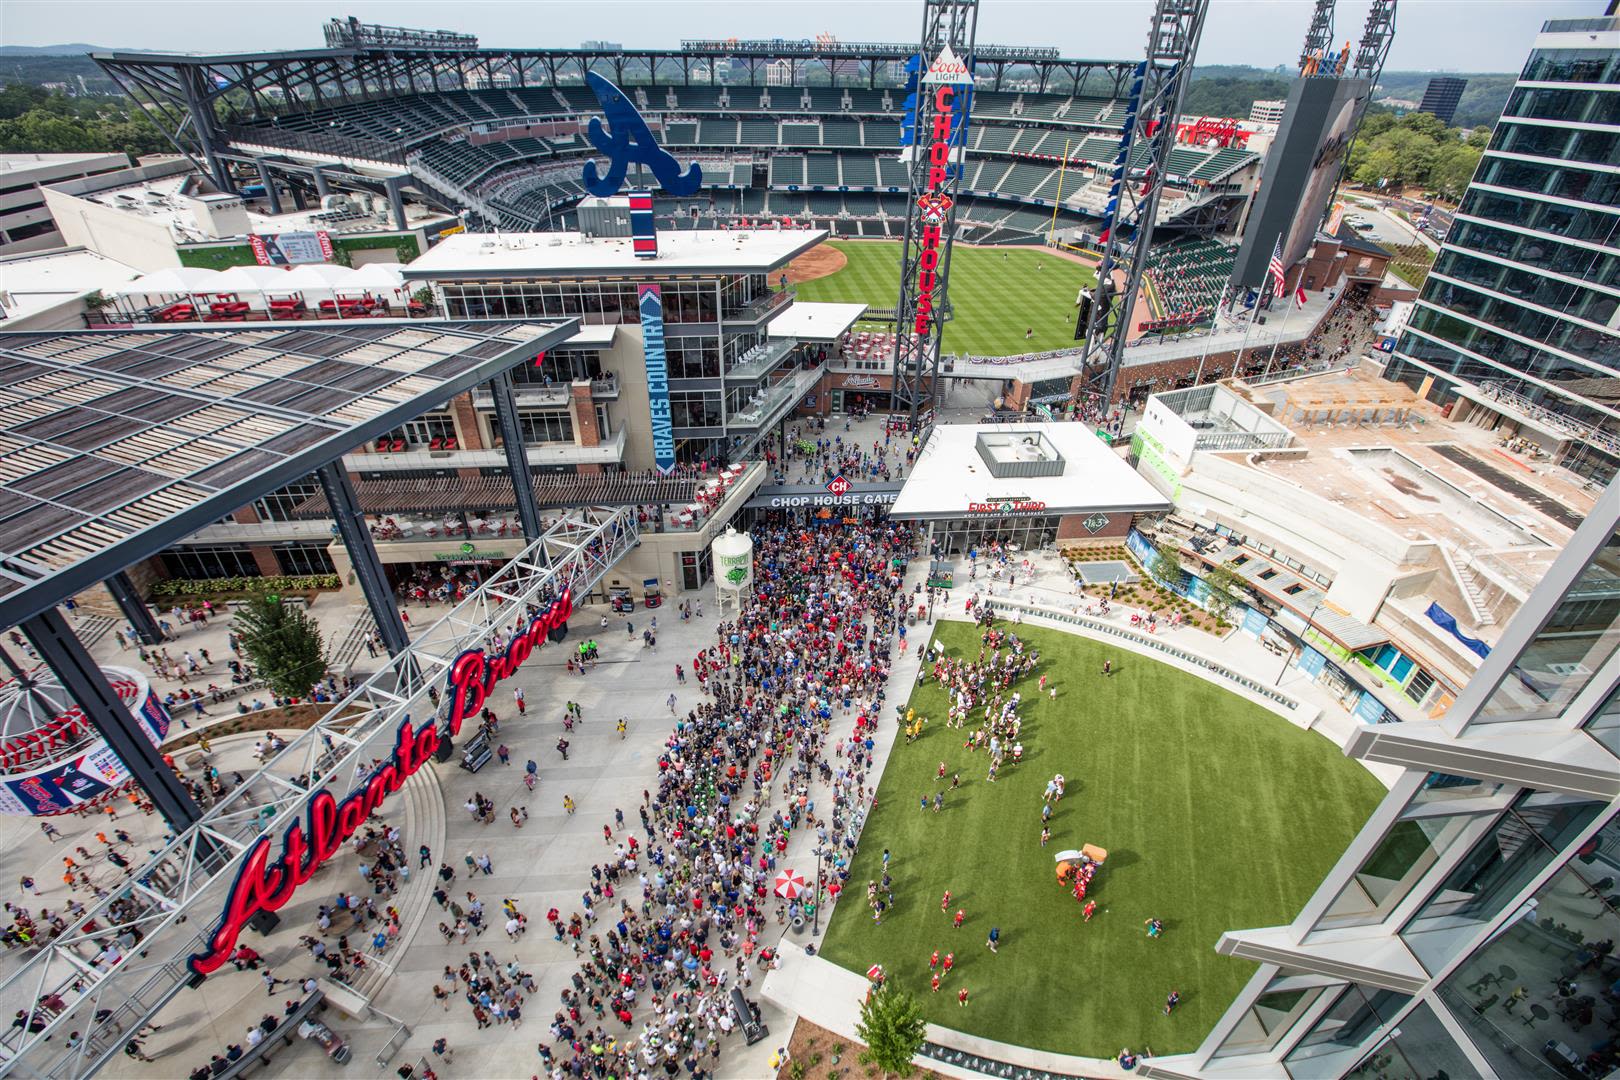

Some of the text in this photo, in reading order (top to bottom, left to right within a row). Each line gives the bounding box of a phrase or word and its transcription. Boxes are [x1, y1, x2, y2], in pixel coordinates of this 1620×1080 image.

[929, 57, 967, 73] Coors
[935, 73, 960, 81] LIGHT
[915, 86, 954, 334] CHOP HOUSE
[641, 313, 675, 459] BRAVES COUNTRY
[831, 481, 847, 492] CH
[771, 494, 898, 508] CHOP HOUSE GATE
[968, 502, 1001, 513] FIRST
[1012, 501, 1046, 512] THIRD
[448, 583, 573, 738] Braves
[187, 714, 442, 974] Atlanta
